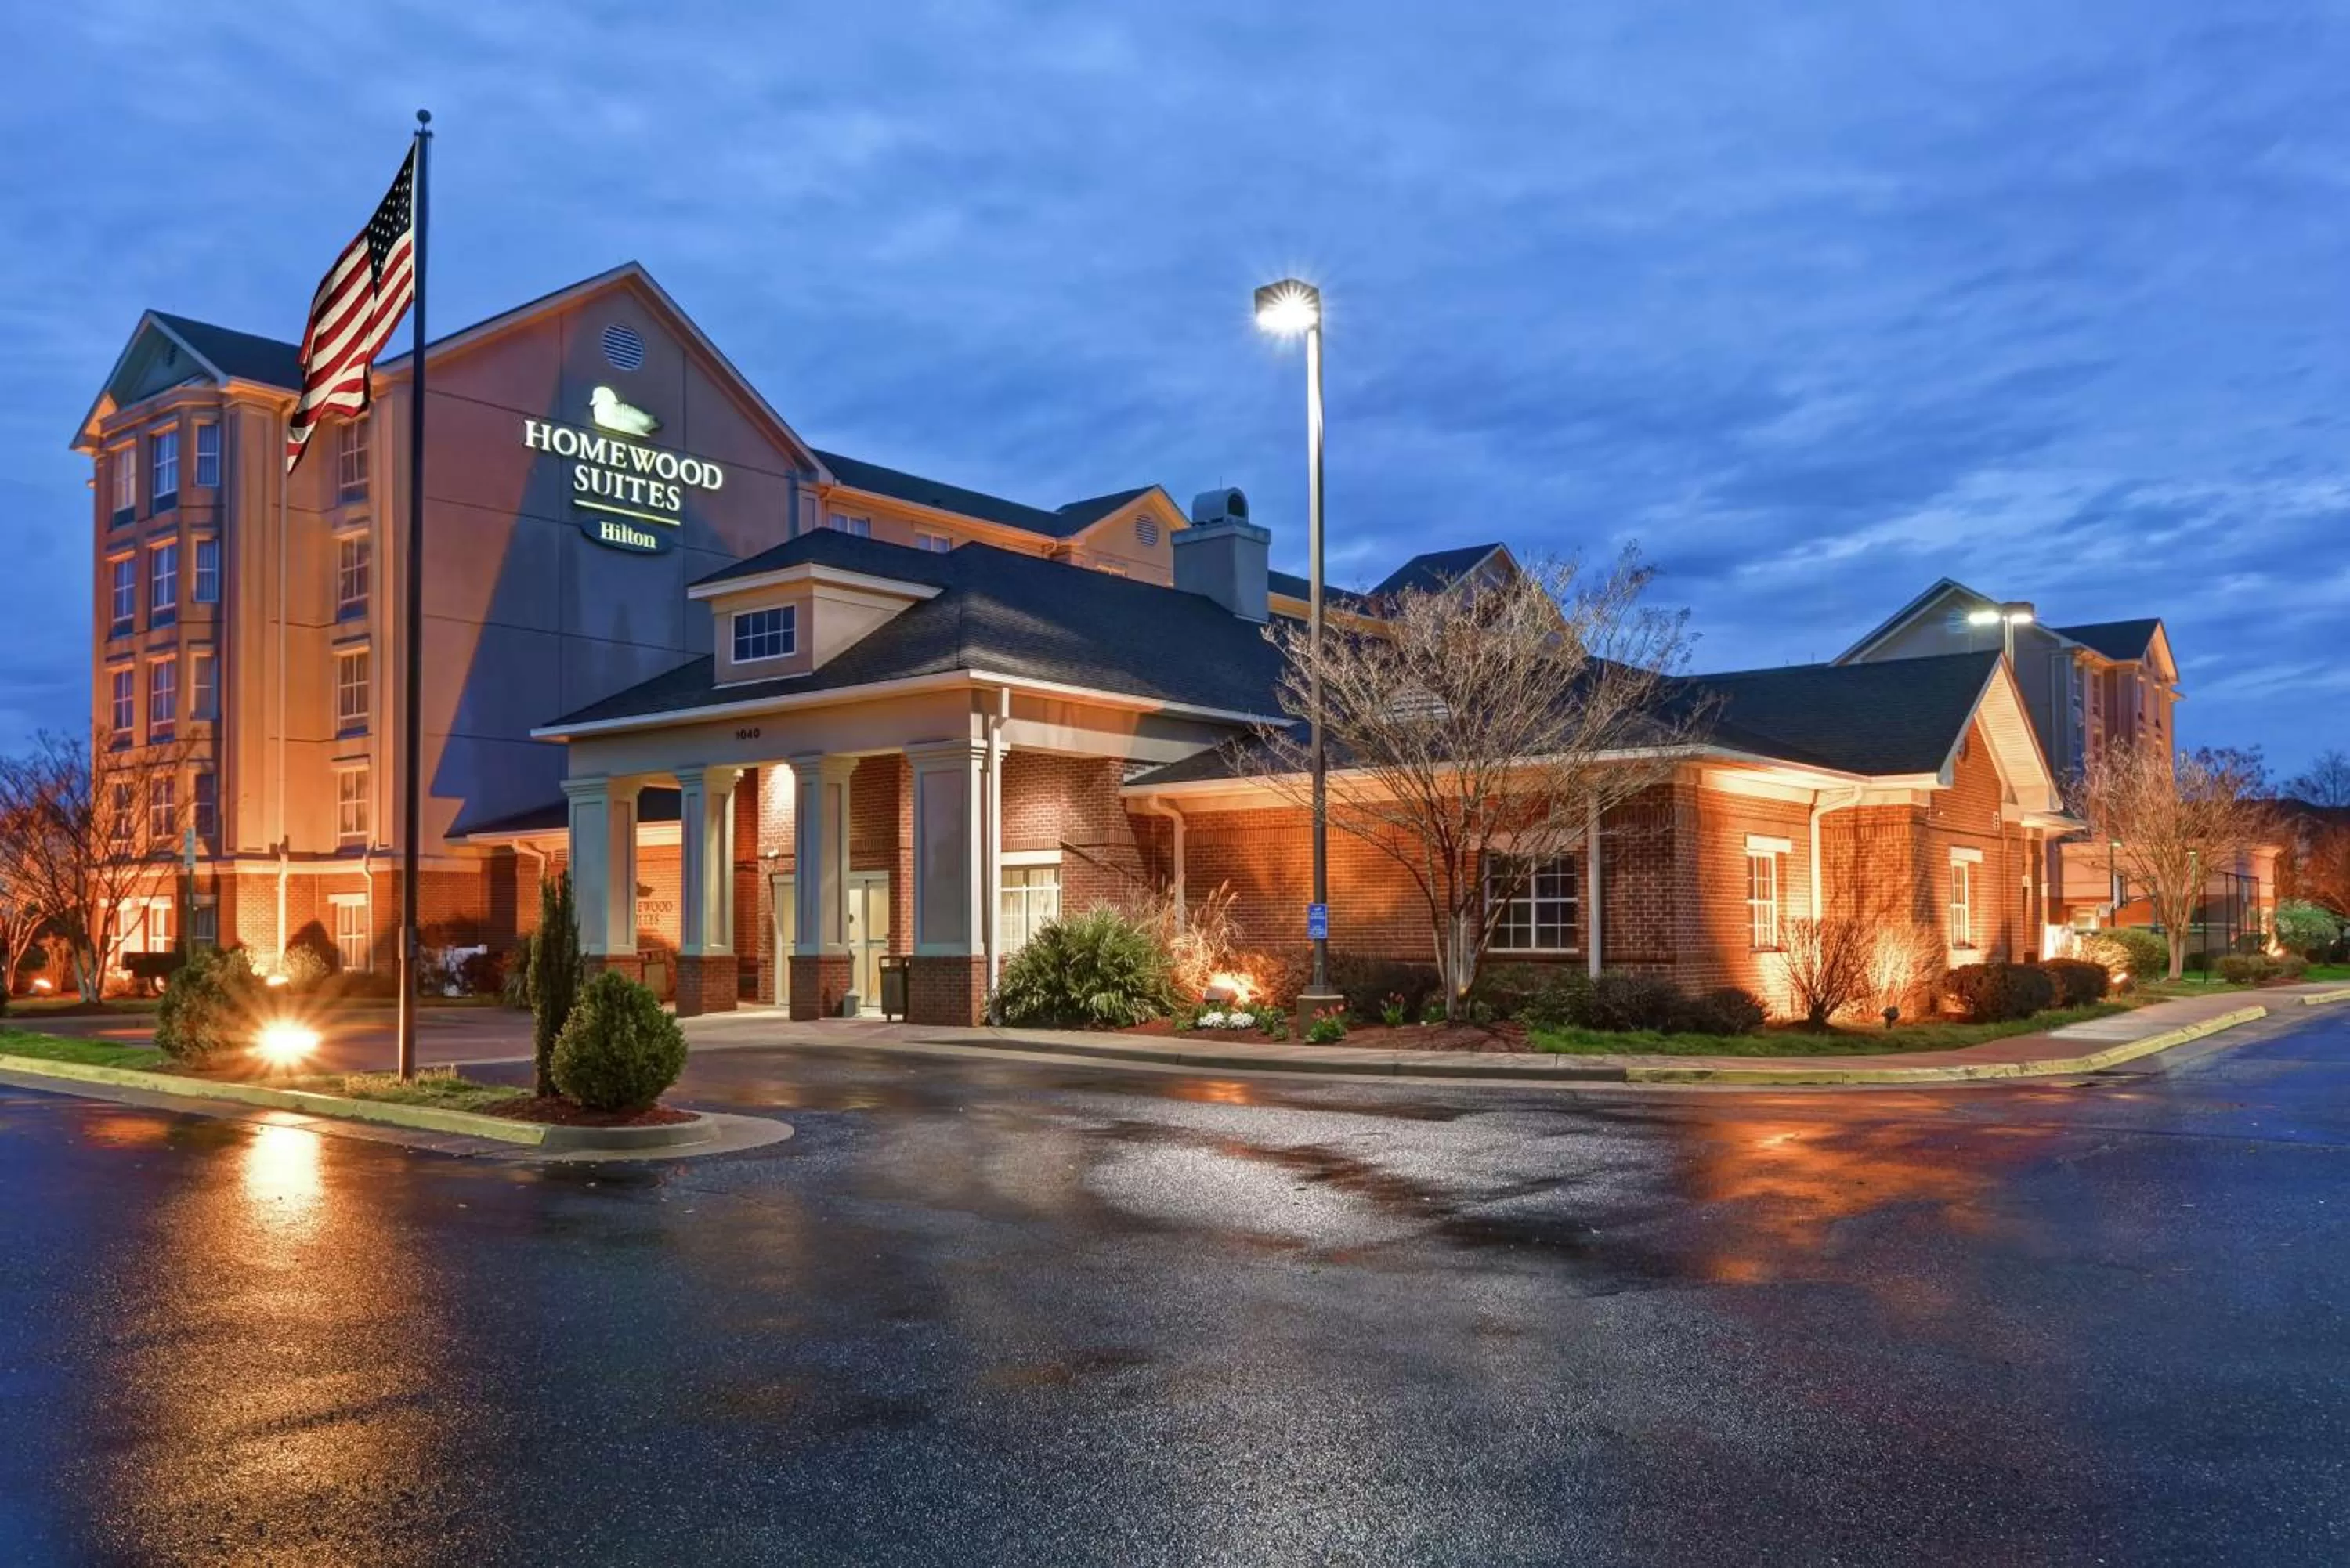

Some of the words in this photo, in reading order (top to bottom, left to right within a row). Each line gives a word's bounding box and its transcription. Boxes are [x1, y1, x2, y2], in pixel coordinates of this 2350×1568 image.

[524, 420, 724, 490] HOMEWOOD
[573, 464, 681, 511] SUITES
[600, 521, 657, 549] Hilton
[736, 728, 761, 740] 1040
[637, 901, 673, 912] EWOOD
